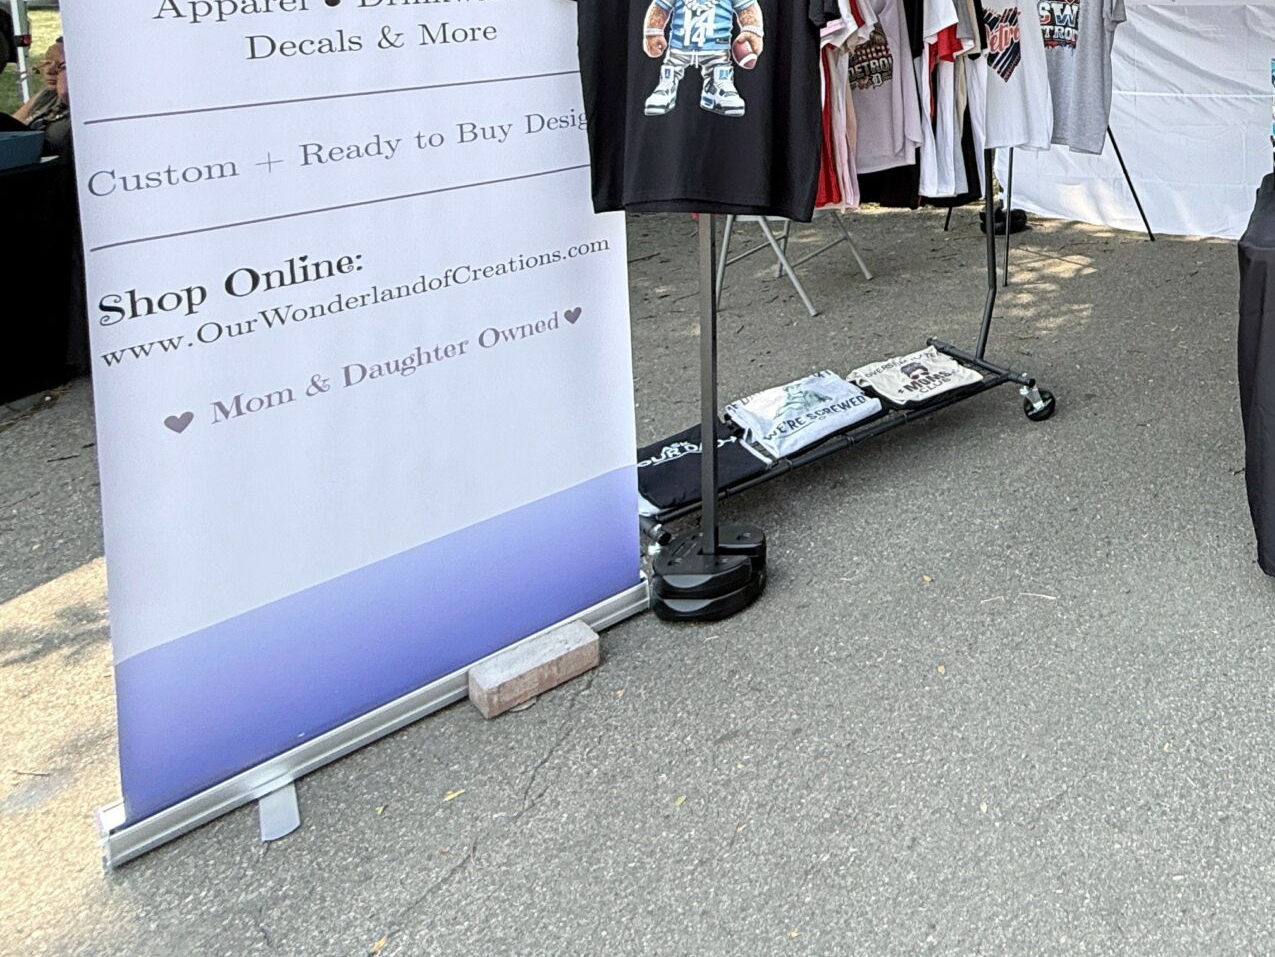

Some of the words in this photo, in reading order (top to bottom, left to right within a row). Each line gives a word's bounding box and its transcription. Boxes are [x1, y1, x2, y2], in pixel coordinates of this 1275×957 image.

[246, 28, 363, 60] Decals
[377, 27, 404, 50] &
[418, 22, 497, 46] More
[87, 161, 240, 197] Custom
[300, 134, 402, 166] Ready
[415, 131, 445, 151] to
[457, 121, 513, 145] Buy
[98, 289, 207, 327] Shop
[225, 251, 364, 301] Online:
[102, 236, 610, 369] www.OurWonderlandofCreations.com
[211, 388, 296, 425] Mom
[305, 374, 331, 397] &
[343, 339, 470, 388] Daughter
[478, 310, 560, 349] Owned
[763, 416, 807, 442] WE'RE
[806, 395, 867, 421] SCREWED
